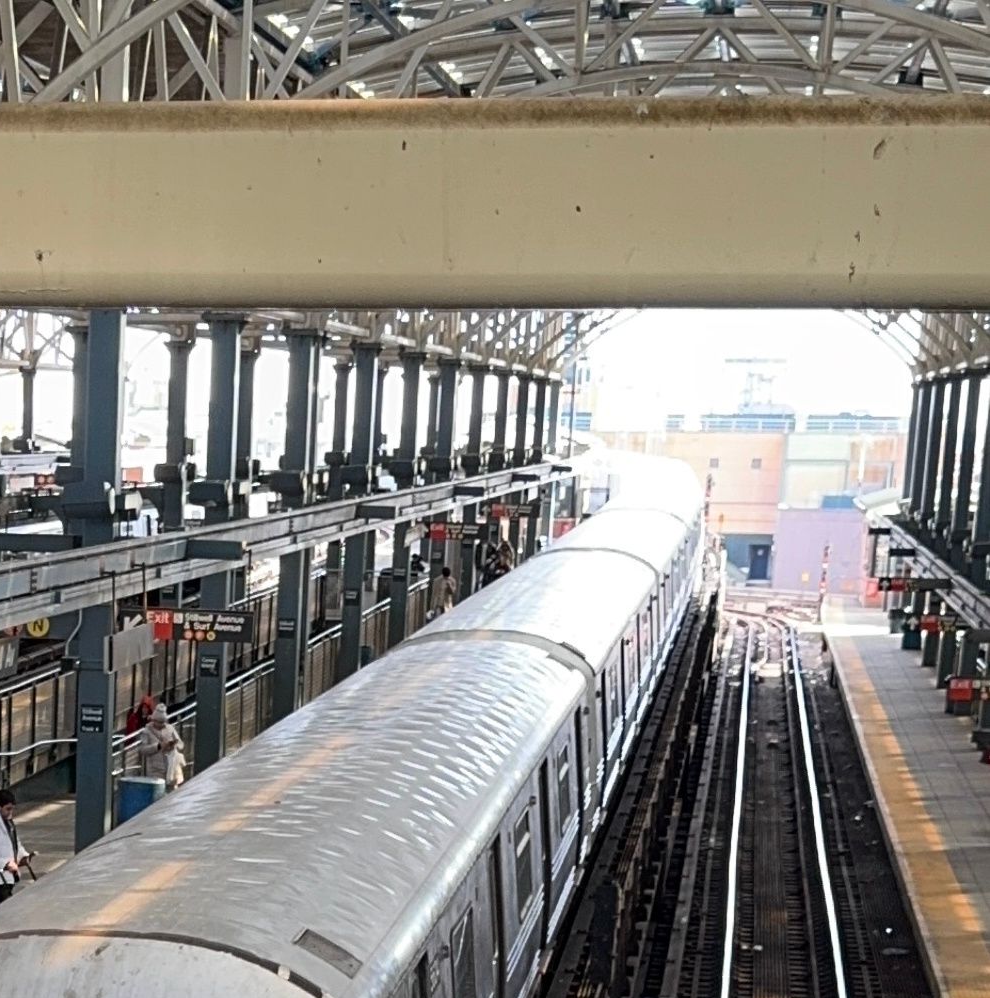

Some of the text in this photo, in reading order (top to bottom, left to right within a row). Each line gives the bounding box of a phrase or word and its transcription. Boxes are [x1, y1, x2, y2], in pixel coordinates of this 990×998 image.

[147, 611, 170, 624] Exit
[217, 614, 245, 625] Avenue
[194, 622, 211, 630] Surf
[213, 623, 242, 632] Avenue
